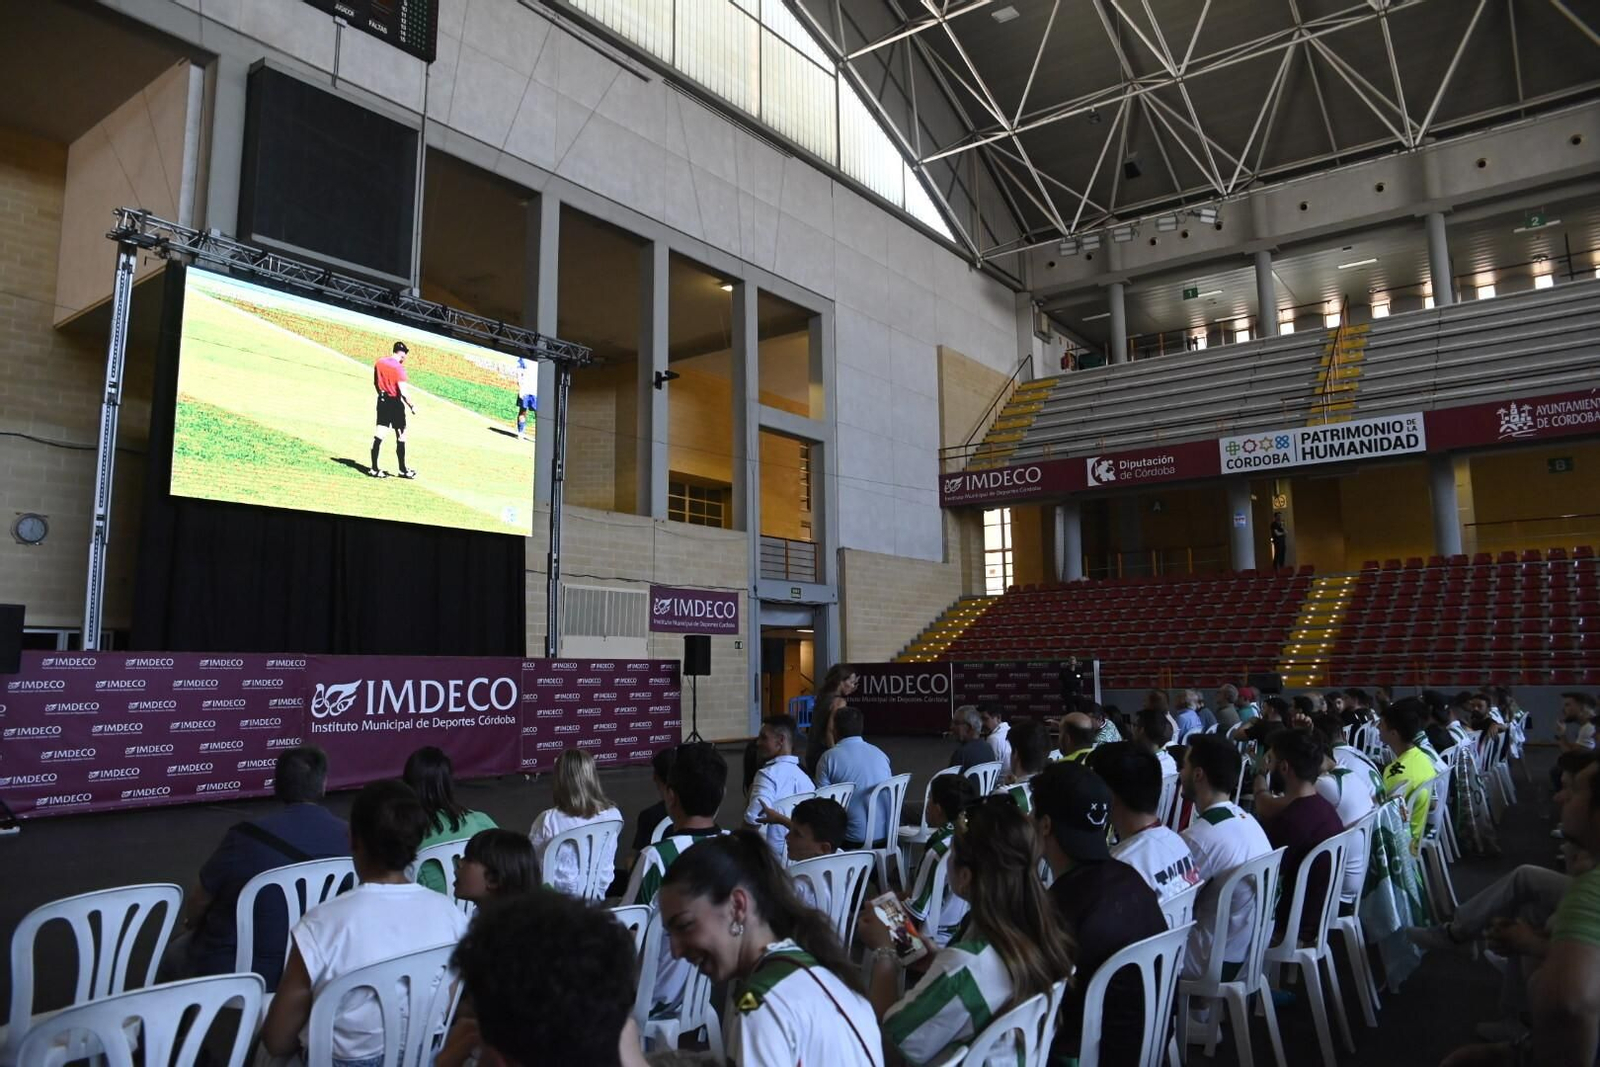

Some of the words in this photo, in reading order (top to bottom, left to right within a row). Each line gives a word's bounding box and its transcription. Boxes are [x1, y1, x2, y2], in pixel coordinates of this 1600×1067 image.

[1531, 216, 1541, 226] 2
[1536, 398, 1600, 416] AYUNTAMIEN
[1537, 418, 1549, 428] DE
[1301, 421, 1404, 445] PATRIMONIO
[1302, 434, 1419, 460] HUMANIDAD
[1120, 455, 1174, 469] Diputación
[1556, 459, 1566, 470] B
[1120, 471, 1132, 480] de
[1135, 465, 1175, 477] Córdoba
[966, 466, 1041, 491] IMDECO
[674, 599, 735, 618] IMDECO
[56, 658, 96, 667] IMDECO
[137, 658, 174, 667] IMDECO
[208, 659, 243, 667] IMDECO
[275, 659, 305, 667] IMDECO
[22, 680, 65, 689] IMDECO
[107, 680, 146, 688] IMDECO
[183, 680, 218, 688] IMDECO
[251, 679, 283, 687] IMDECO
[863, 674, 948, 694] IMDECO
[366, 677, 517, 715] IMDECO
[58, 702, 99, 711] IMDECO
[139, 700, 176, 709] IMDECO
[211, 699, 245, 707] IMDECO
[278, 698, 303, 706] IMDEC
[179, 720, 216, 729] IMDECO
[248, 718, 281, 727] IMDECO
[311, 721, 358, 733] Instituto
[361, 719, 413, 732] Municipal
[416, 718, 428, 728] de
[432, 717, 475, 729] Deportes
[478, 715, 516, 726] Córdoba
[18, 726, 61, 735] IMDECO
[104, 723, 142, 732] IMDECO
[209, 740, 243, 749] IMDECO
[276, 738, 301, 746] IMDEC
[54, 749, 95, 758] IMDECO
[135, 744, 173, 754] IMDECO
[178, 763, 213, 772] IMDECO
[101, 768, 139, 778] IMDECO
[13, 773, 57, 783] IMDECO
[207, 781, 241, 791] IMDECO
[133, 787, 170, 797] IMDECO
[49, 794, 91, 804] IMDECO
